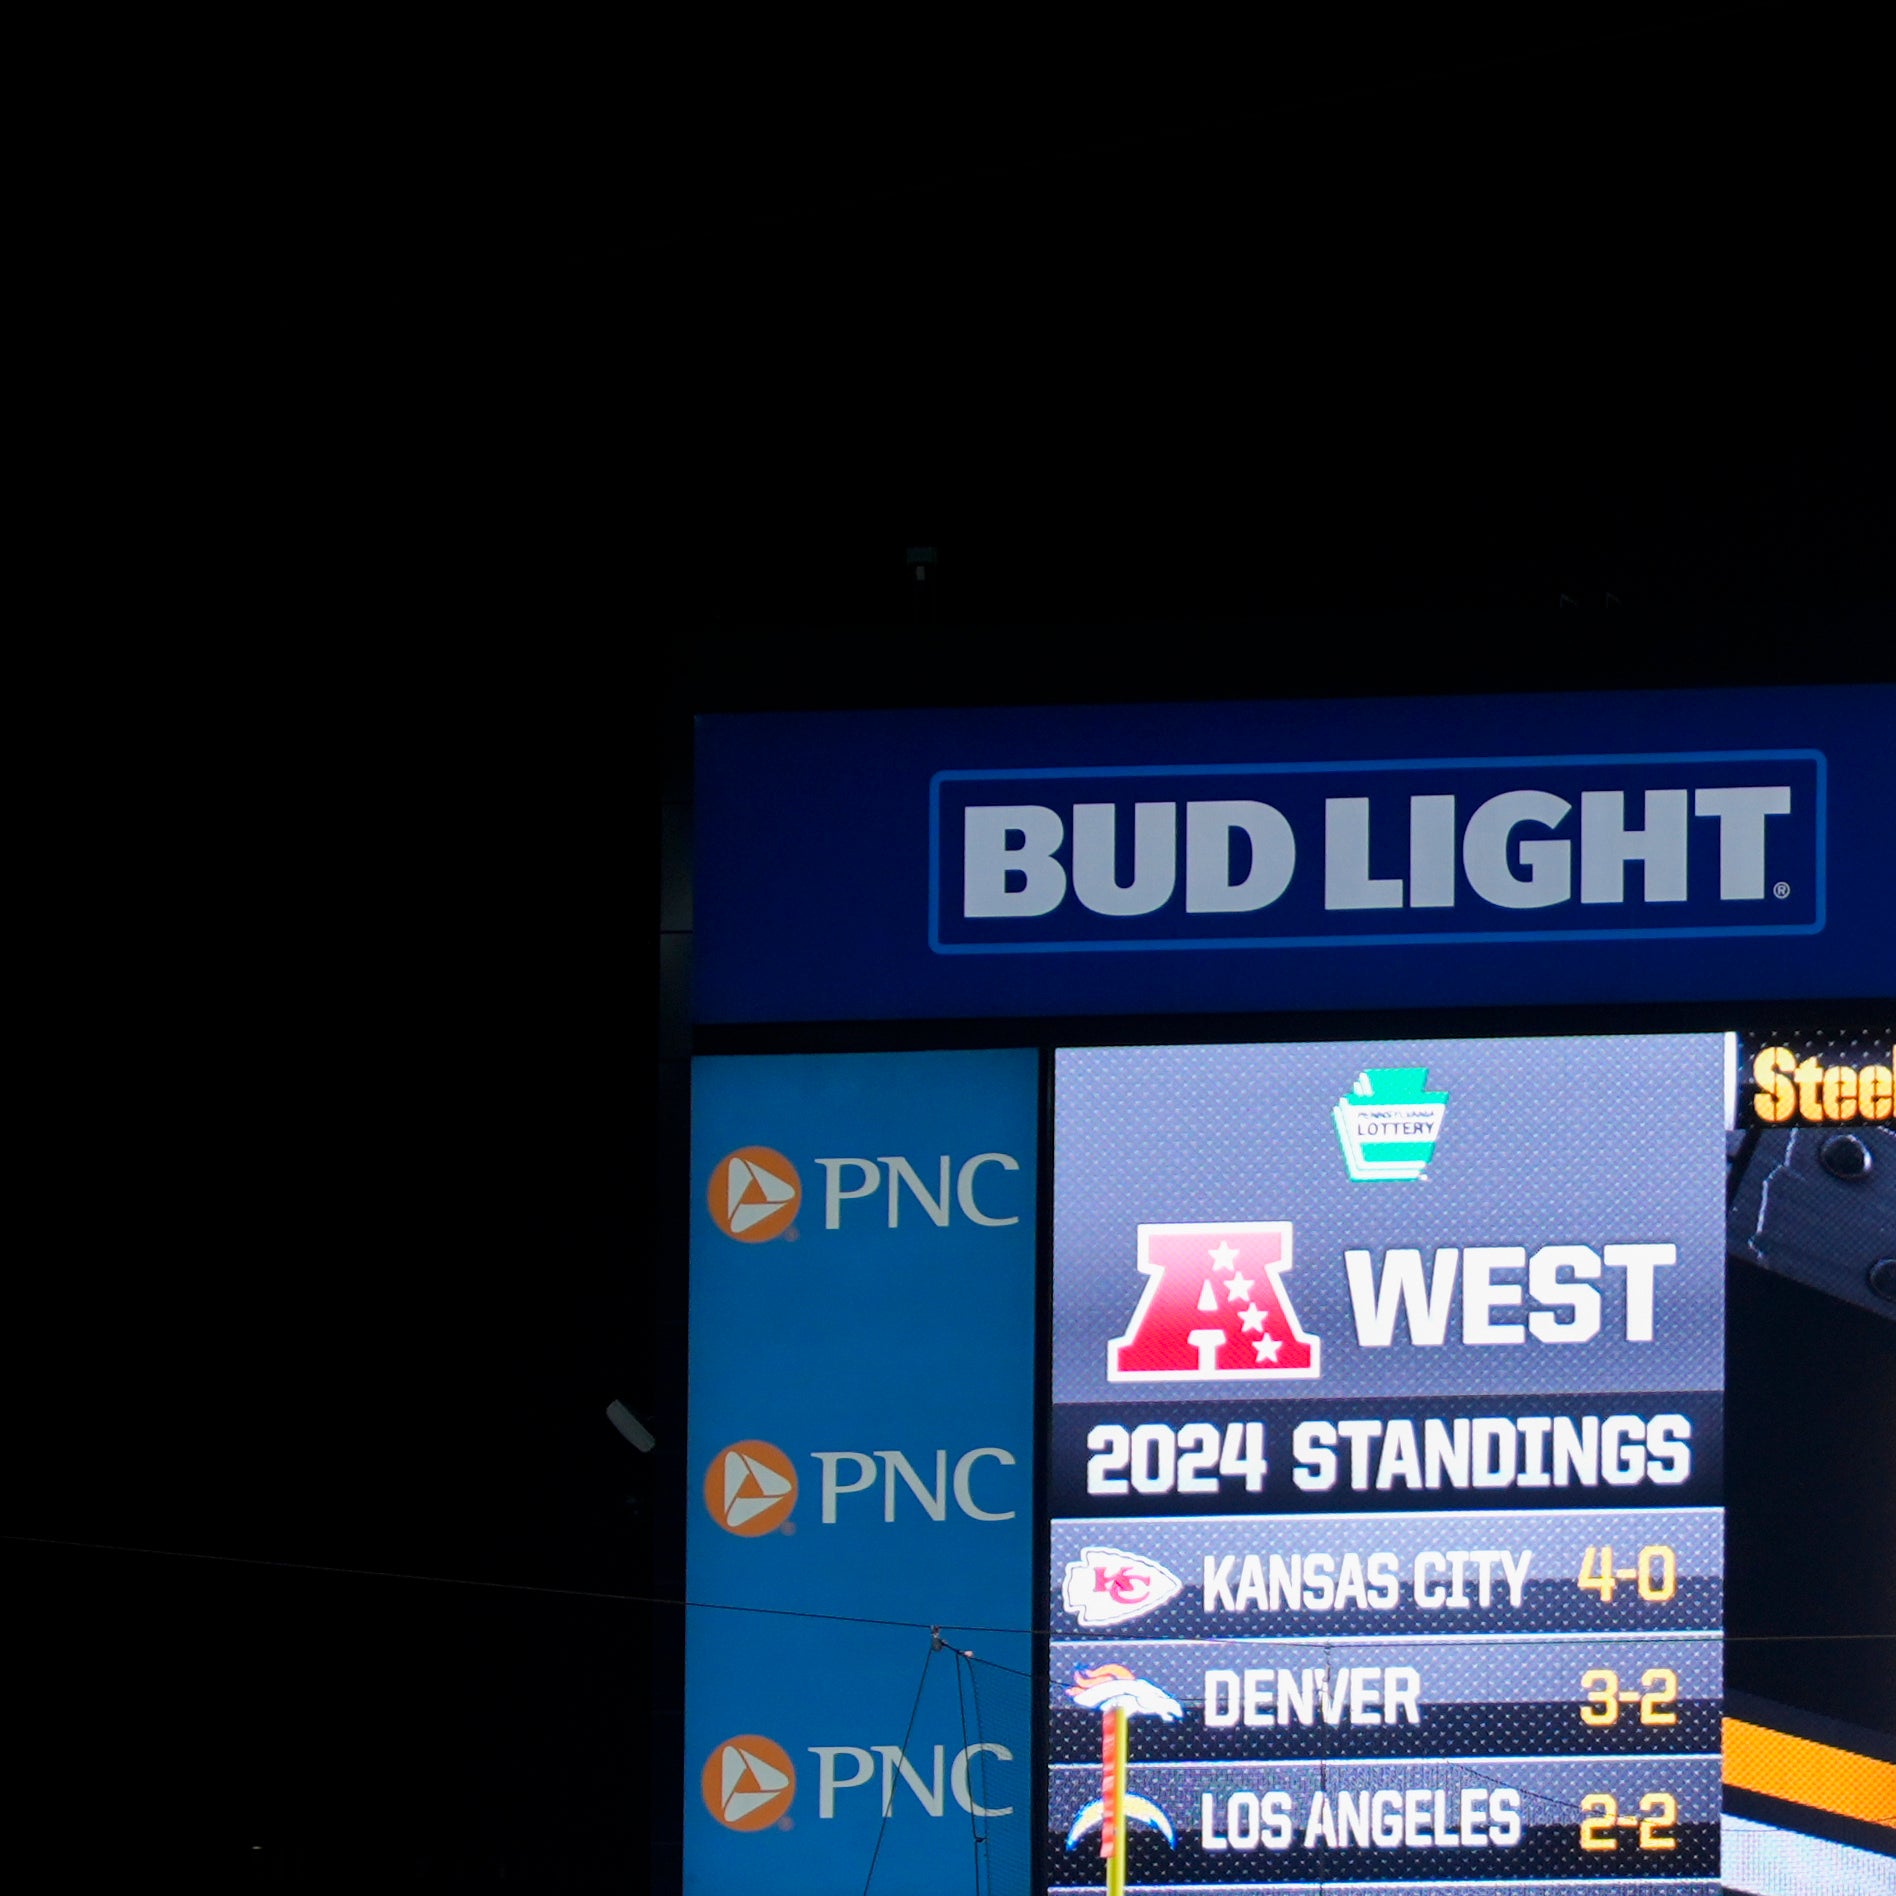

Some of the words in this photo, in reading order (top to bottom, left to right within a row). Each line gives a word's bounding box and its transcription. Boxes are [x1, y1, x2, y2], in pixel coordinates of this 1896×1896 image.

[964, 798, 1296, 918] BUD
[1324, 786, 1790, 910] LIGHT
[1357, 1121, 1434, 1136] LOTTERY
[814, 1152, 1020, 1230] PNC
[1344, 1243, 1677, 1347] WEST
[811, 1446, 1016, 1524] PNC
[1086, 1421, 1266, 1496] 2024
[1292, 1415, 1691, 1491] STANDINGS
[1201, 1551, 1400, 1613] KANSAS
[1413, 1549, 1531, 1609] CITY
[1577, 1544, 1677, 1603] 4-0
[1202, 1666, 1420, 1727] DENVER
[1579, 1667, 1679, 1727] 3-2
[808, 1741, 1016, 1819] PNC
[1201, 1792, 1293, 1850] LOS
[1304, 1788, 1521, 1847] ANGELES
[1579, 1793, 1679, 1852] 2-2
